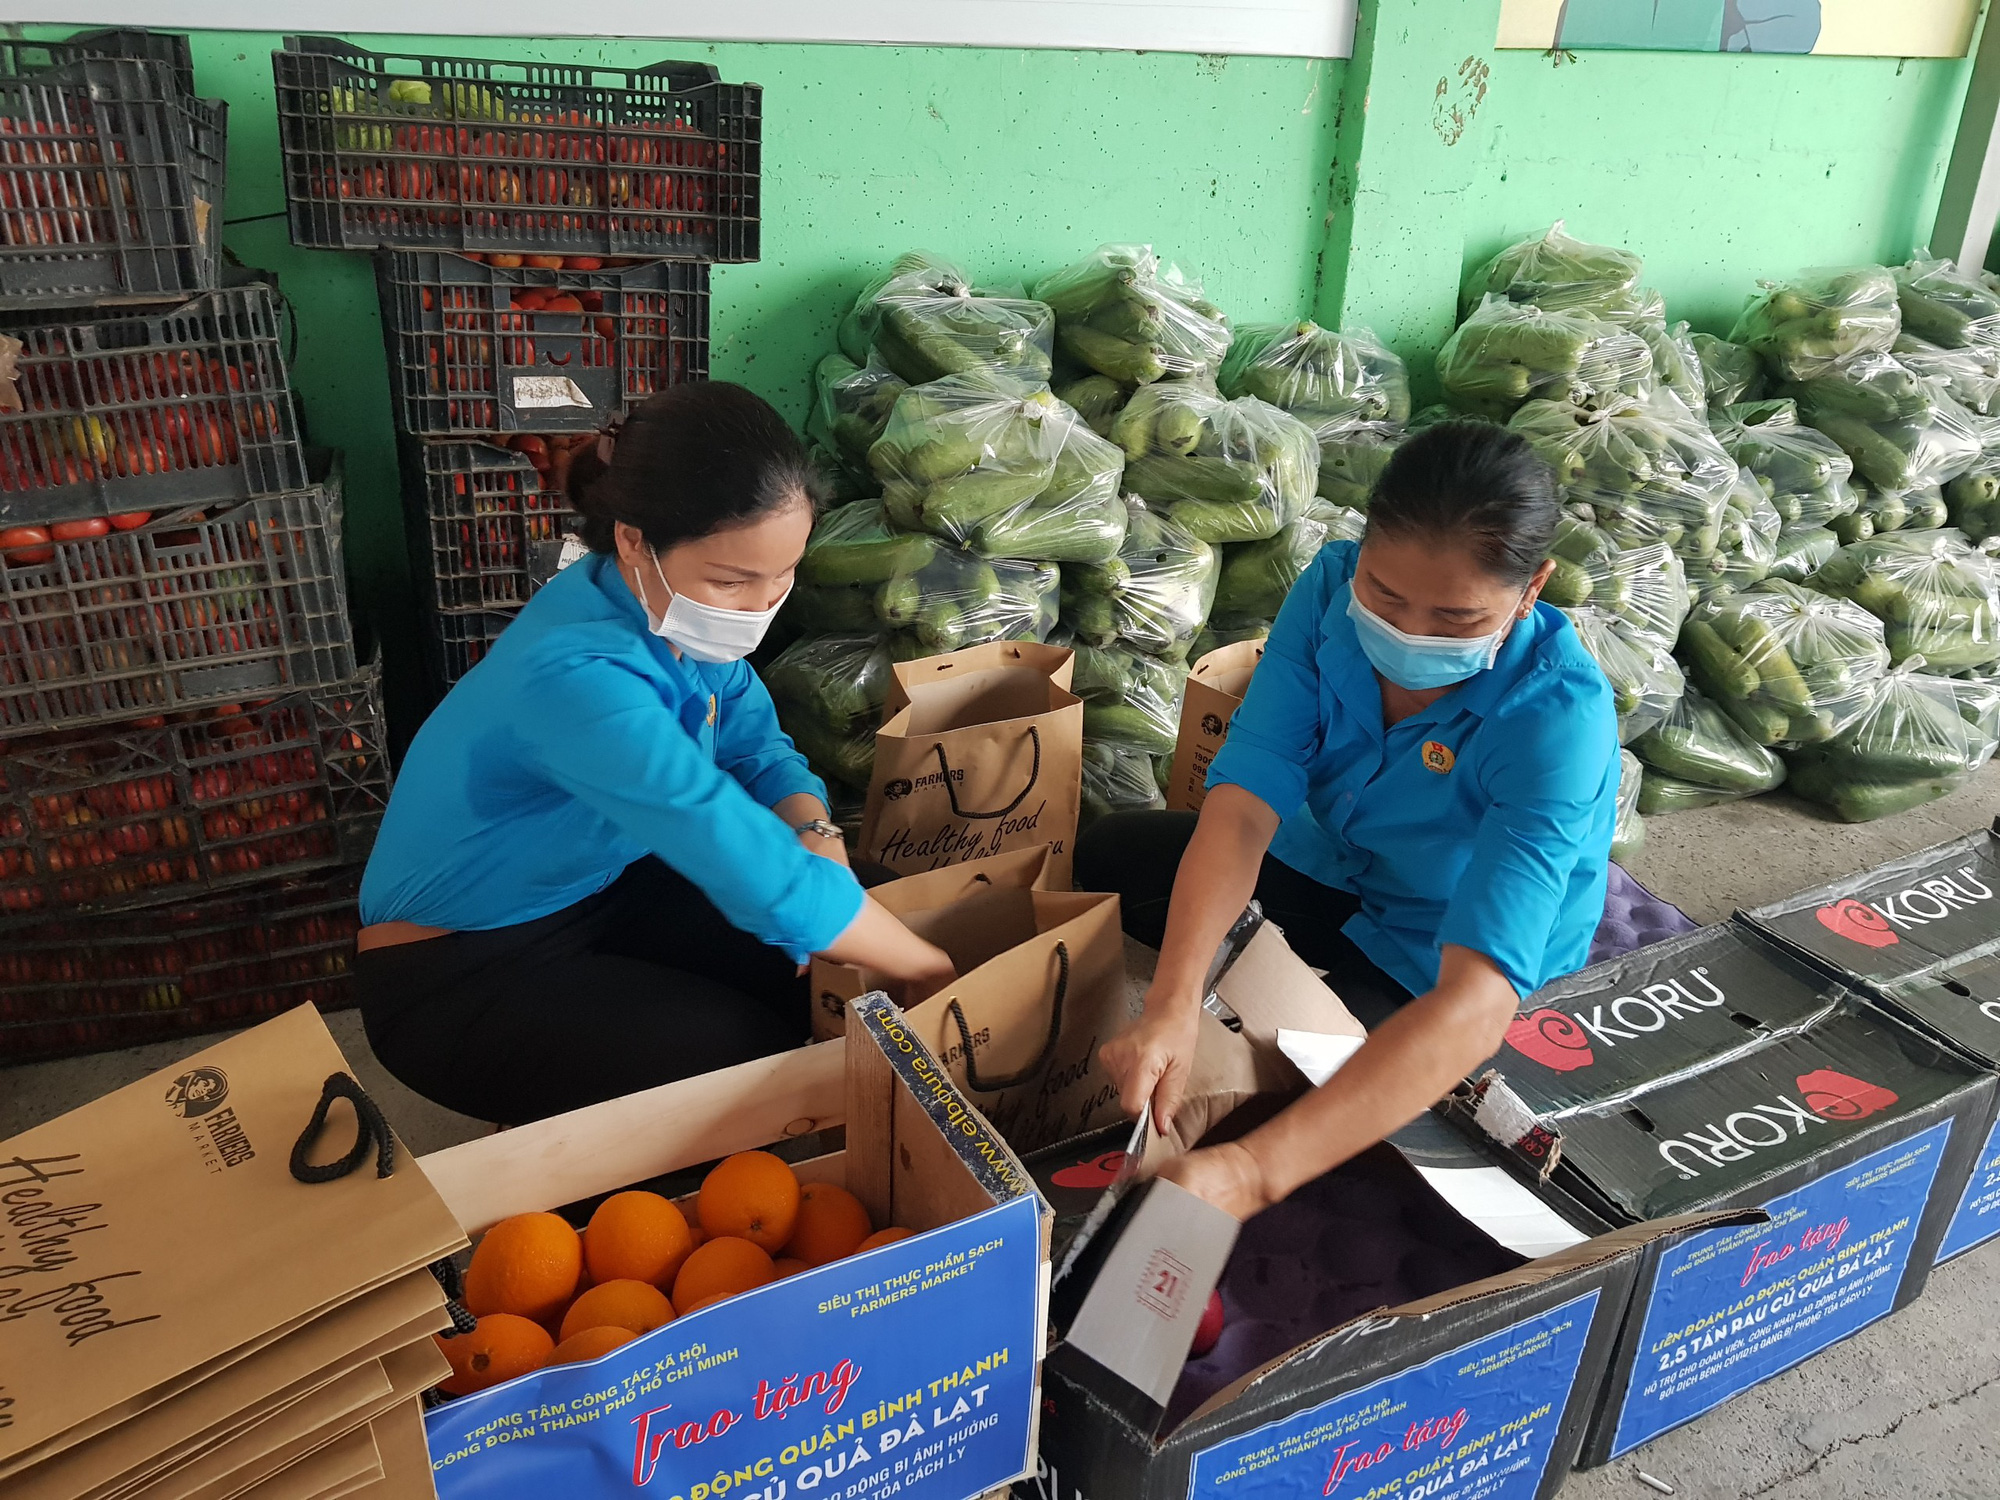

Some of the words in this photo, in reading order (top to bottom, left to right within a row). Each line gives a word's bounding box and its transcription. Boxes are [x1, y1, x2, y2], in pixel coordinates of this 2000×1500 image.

[913, 782, 964, 793] MARKT
[914, 769, 964, 788] FARMRS
[880, 823, 984, 865] Healthy
[991, 800, 1047, 851] food
[188, 1122, 222, 1174] MARKET
[204, 1106, 256, 1168] FARMERS
[1856, 1172, 1888, 1190] FARMERS
[1889, 1158, 1916, 1175] MARKET
[0, 1153, 109, 1279] Healthy
[1687, 1244, 1714, 1261] TRUNG
[1715, 1235, 1733, 1248] TÂM
[1734, 1225, 1755, 1240] CÔNG
[1740, 1240, 1795, 1287] Trao
[1799, 1216, 1850, 1252] tặng
[818, 1293, 851, 1313] SIÊU
[855, 1283, 880, 1302] THỊ
[883, 1269, 922, 1291] THỰC
[925, 1251, 964, 1276] PHẨM
[968, 1237, 1004, 1259] SẠCH
[851, 1285, 918, 1318] FARMERS
[921, 1261, 977, 1291] MARKET
[1651, 1329, 1683, 1354] LIÊN
[1684, 1309, 1726, 1338] ĐOÀN
[1727, 1294, 1755, 1316] LAO
[1756, 1274, 1795, 1301] ĐỘNG
[1798, 1255, 1835, 1280] QUẬN
[1837, 1238, 1867, 1262] BÌNH
[1869, 1216, 1910, 1244] THẠNH
[1671, 1262, 1693, 1278] CÔNG
[1693, 1251, 1716, 1267] ĐOÀN
[1717, 1239, 1744, 1256] THÀNH
[6, 1270, 162, 1348] food
[1658, 1344, 1688, 1371] 2,5
[1690, 1324, 1728, 1354] TẤN
[1731, 1304, 1768, 1335] RAU
[1770, 1286, 1796, 1314] CỦ
[1798, 1267, 1834, 1299] QUẢ
[1836, 1253, 1860, 1279] ĐÀ
[1862, 1240, 1895, 1266] LẠT
[1678, 1361, 1697, 1378] CHO
[1698, 1348, 1723, 1368] ĐOÀN
[1748, 1324, 1772, 1342] CÔNG
[1797, 1302, 1814, 1318] LAO
[1458, 1362, 1479, 1376] SIÊU
[1481, 1354, 1496, 1369] THỊ
[1549, 1320, 1573, 1336] SẠCH
[1474, 1355, 1516, 1378] FARMERS
[1517, 1337, 1554, 1359] MARKET
[1676, 1375, 1698, 1392] DỊCH
[1699, 1361, 1722, 1381] BỆNH
[1723, 1343, 1759, 1368] COVID19
[1760, 1330, 1783, 1349] ĐANG
[1784, 1325, 1794, 1337] BỊ
[1794, 1311, 1822, 1331] PHONG
[432, 1441, 481, 1471] CÔNG
[485, 1425, 535, 1448] ĐOÀN
[541, 1409, 600, 1433] THÀNH
[605, 1385, 636, 1414] PHỐ
[641, 1372, 662, 1395] HỒ
[666, 1363, 693, 1383] CHÍ
[698, 1347, 739, 1372] MINH
[464, 1413, 523, 1441] TRUNG
[527, 1402, 566, 1422] TÂM
[571, 1386, 618, 1410] CÔNG
[621, 1366, 651, 1388] TÁC
[655, 1353, 675, 1373] XÃ
[680, 1342, 707, 1362] HỘI
[629, 1404, 742, 1487] Trao
[752, 1358, 862, 1419] tặng
[690, 1457, 774, 1500] ĐỘNG
[780, 1419, 855, 1465] QUẬN
[861, 1389, 922, 1430] BÌNH
[928, 1348, 1009, 1398] THẠNH
[796, 1436, 872, 1490] QUẢ
[879, 1413, 926, 1454] ĐÀ
[933, 1384, 990, 1428] LẠT
[845, 1467, 890, 1499] ĐỘNG
[894, 1457, 909, 1475] BỊ
[912, 1441, 943, 1466] ẢNH
[948, 1413, 999, 1448] HƯỞNG
[905, 1458, 944, 1486] CÁCH
[948, 1445, 966, 1465] LY
[1215, 1467, 1246, 1485] CÔNG
[1249, 1454, 1280, 1472] ĐOÀN
[1283, 1439, 1318, 1459] THÀNH
[1321, 1427, 1343, 1445] PHỐ
[1345, 1419, 1360, 1435] HỒ
[1362, 1412, 1381, 1428] CHÍ
[1381, 1401, 1407, 1419] MINH
[1238, 1445, 1275, 1465] TRUNG
[1278, 1435, 1301, 1450] TÂM
[1304, 1422, 1333, 1440] CÔNG
[1336, 1411, 1356, 1427] TÁC
[1357, 1404, 1371, 1419] XÃ
[1373, 1398, 1391, 1412] HỘI
[1323, 1440, 1396, 1497] Trao
[1401, 1407, 1470, 1452] tặng
[1405, 1452, 1454, 1484] QUẬN
[1457, 1431, 1496, 1460] BÌNH
[1499, 1402, 1552, 1438] THẠNH
[1408, 1465, 1454, 1500] QUẢ
[1459, 1448, 1489, 1478] ĐÀ
[1493, 1429, 1534, 1461] LẠT
[1492, 1477, 1506, 1492] LY
